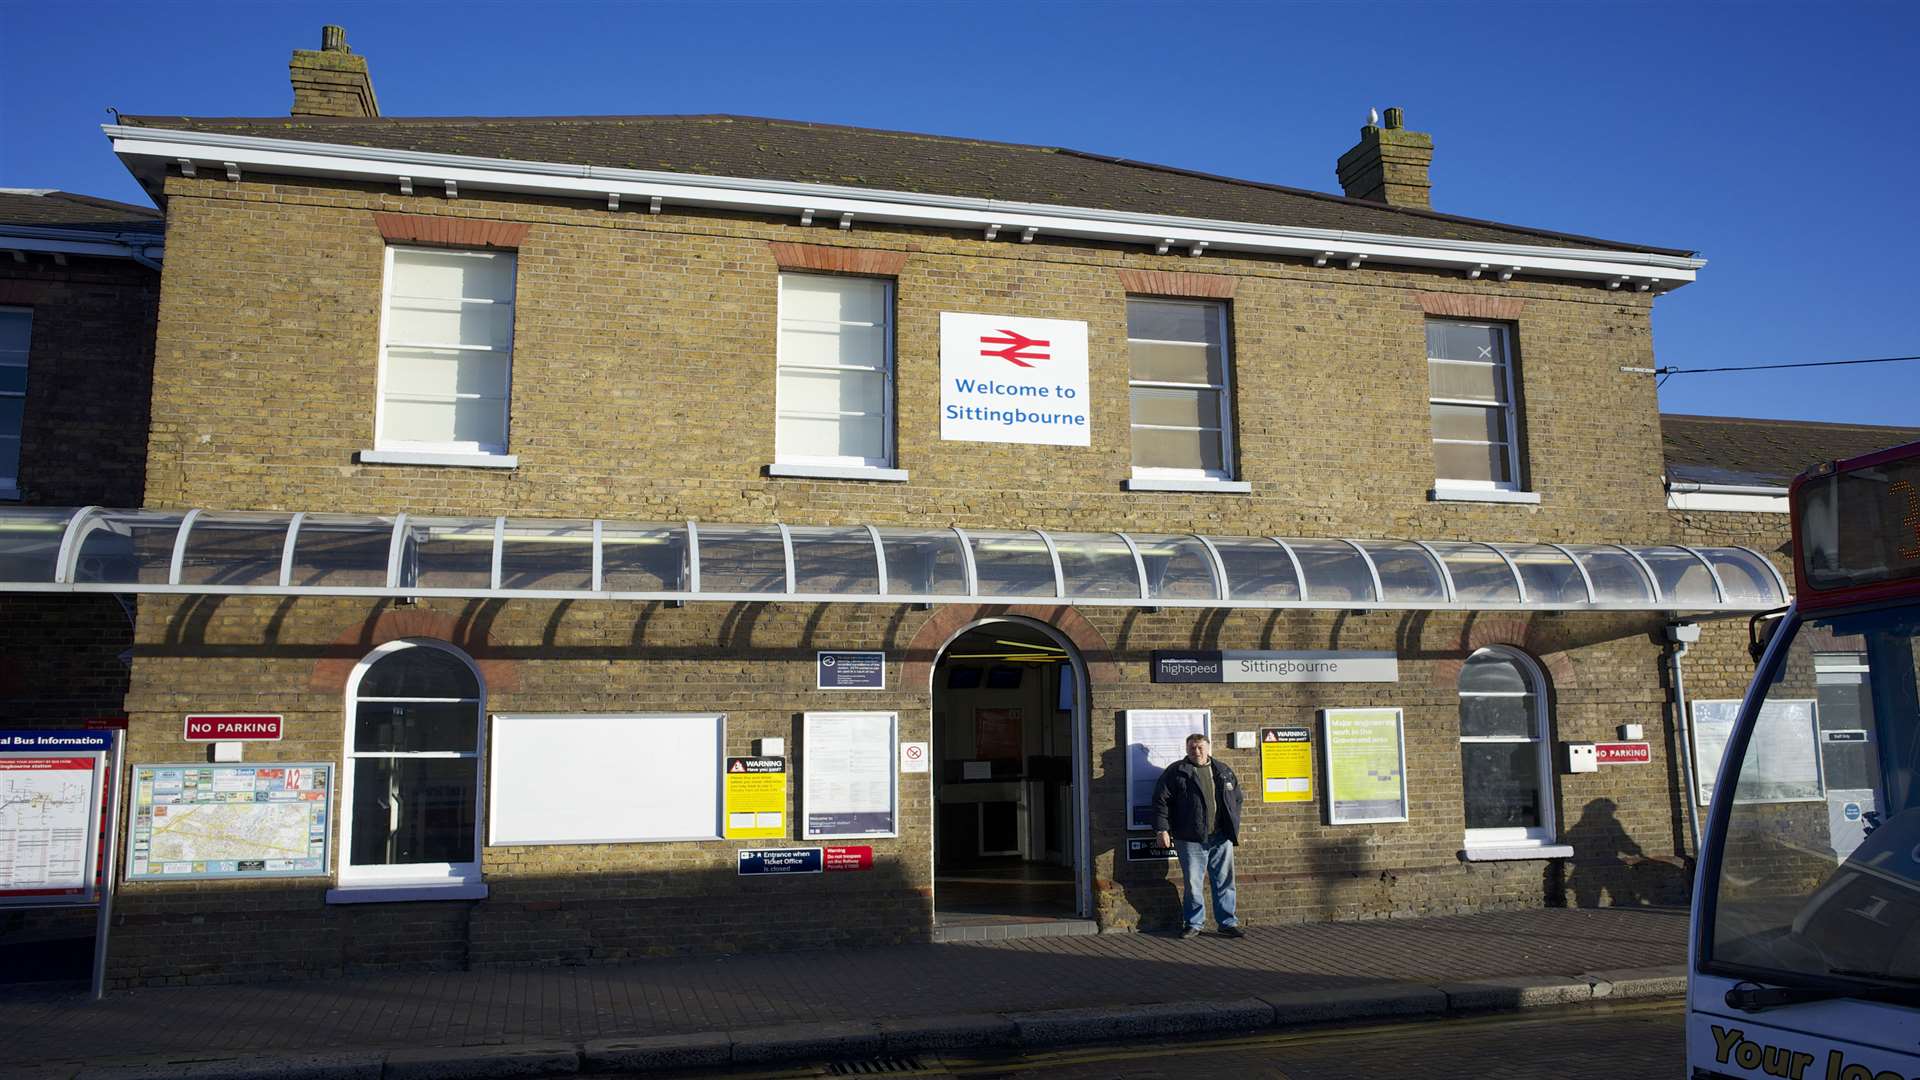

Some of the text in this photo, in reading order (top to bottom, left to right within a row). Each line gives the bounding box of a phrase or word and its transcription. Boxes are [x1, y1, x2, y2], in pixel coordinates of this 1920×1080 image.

[955, 378, 1076, 399] Welcome to
[946, 404, 1085, 426] Sittingbourne
[1161, 663, 1217, 676] highspeed
[1241, 660, 1338, 675] Sittingbourne
[191, 723, 277, 733] NO PARKING
[14, 737, 34, 745] Bus
[38, 737, 104, 745] Information
[1610, 749, 1647, 757] PARKING
[286, 769, 300, 790] A2
[1711, 1025, 1815, 1080] Your
